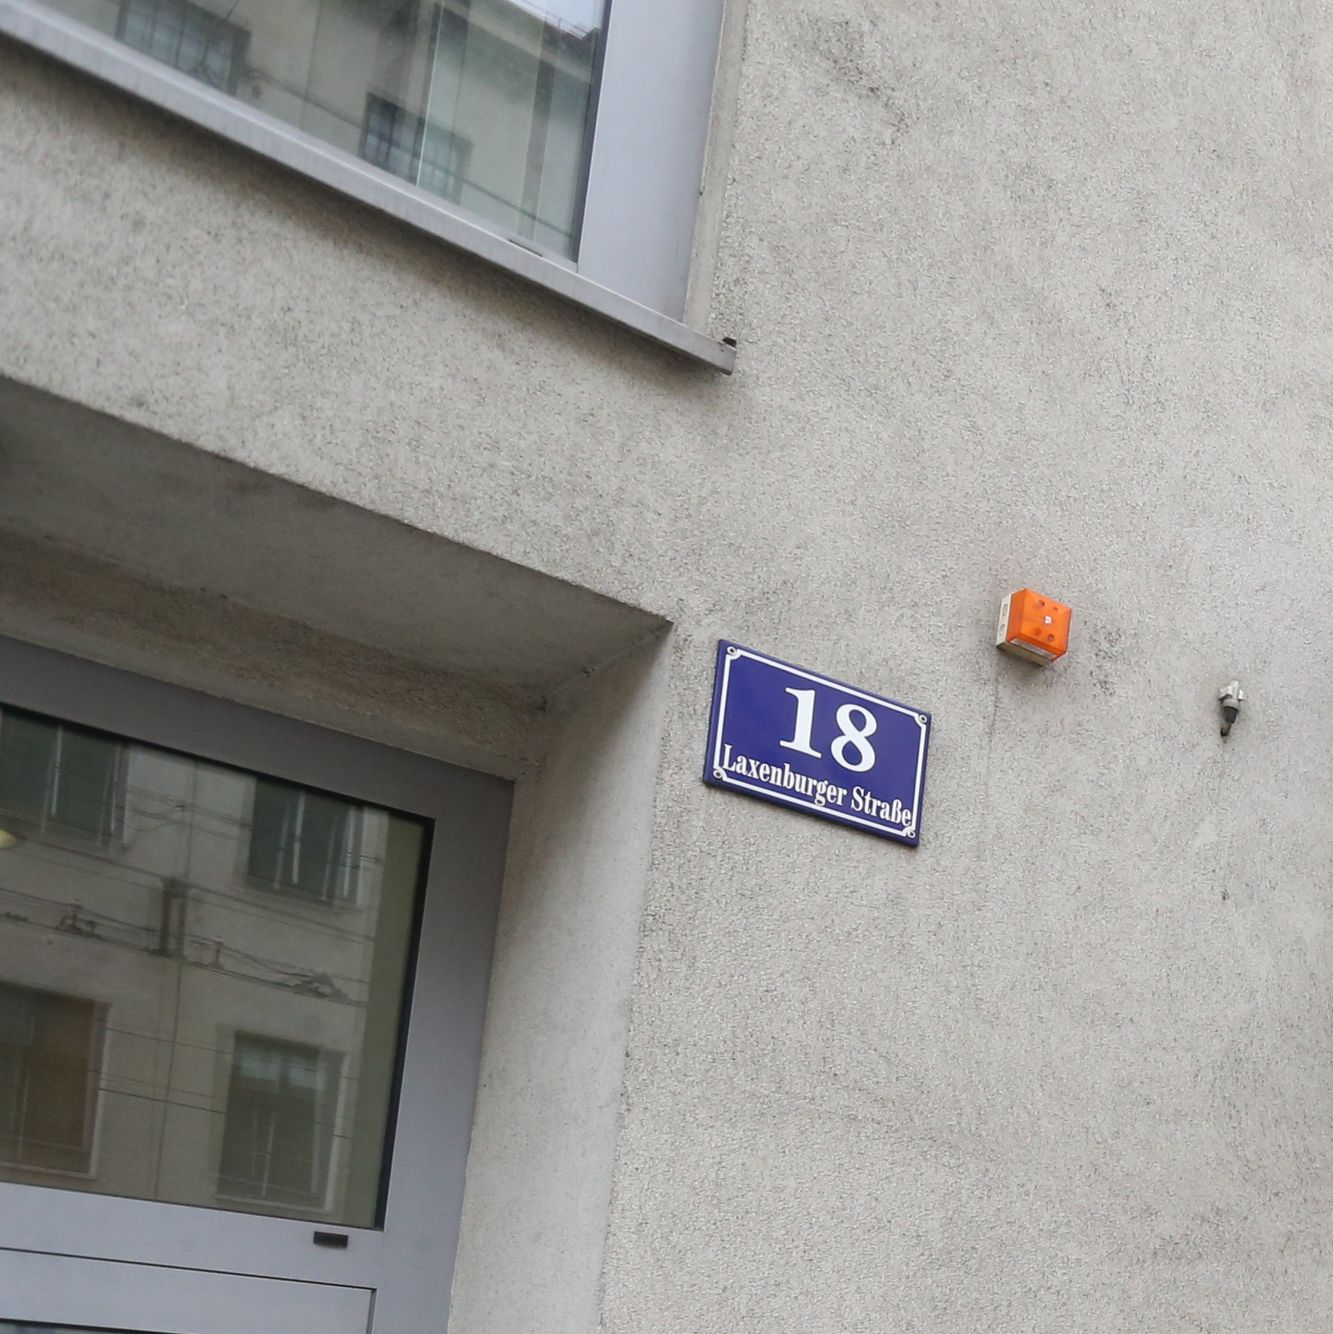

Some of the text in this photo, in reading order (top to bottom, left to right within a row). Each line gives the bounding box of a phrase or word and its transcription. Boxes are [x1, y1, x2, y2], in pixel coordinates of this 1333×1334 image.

[779, 687, 878, 772] 18
[723, 744, 912, 826] Laxenburger Straße
